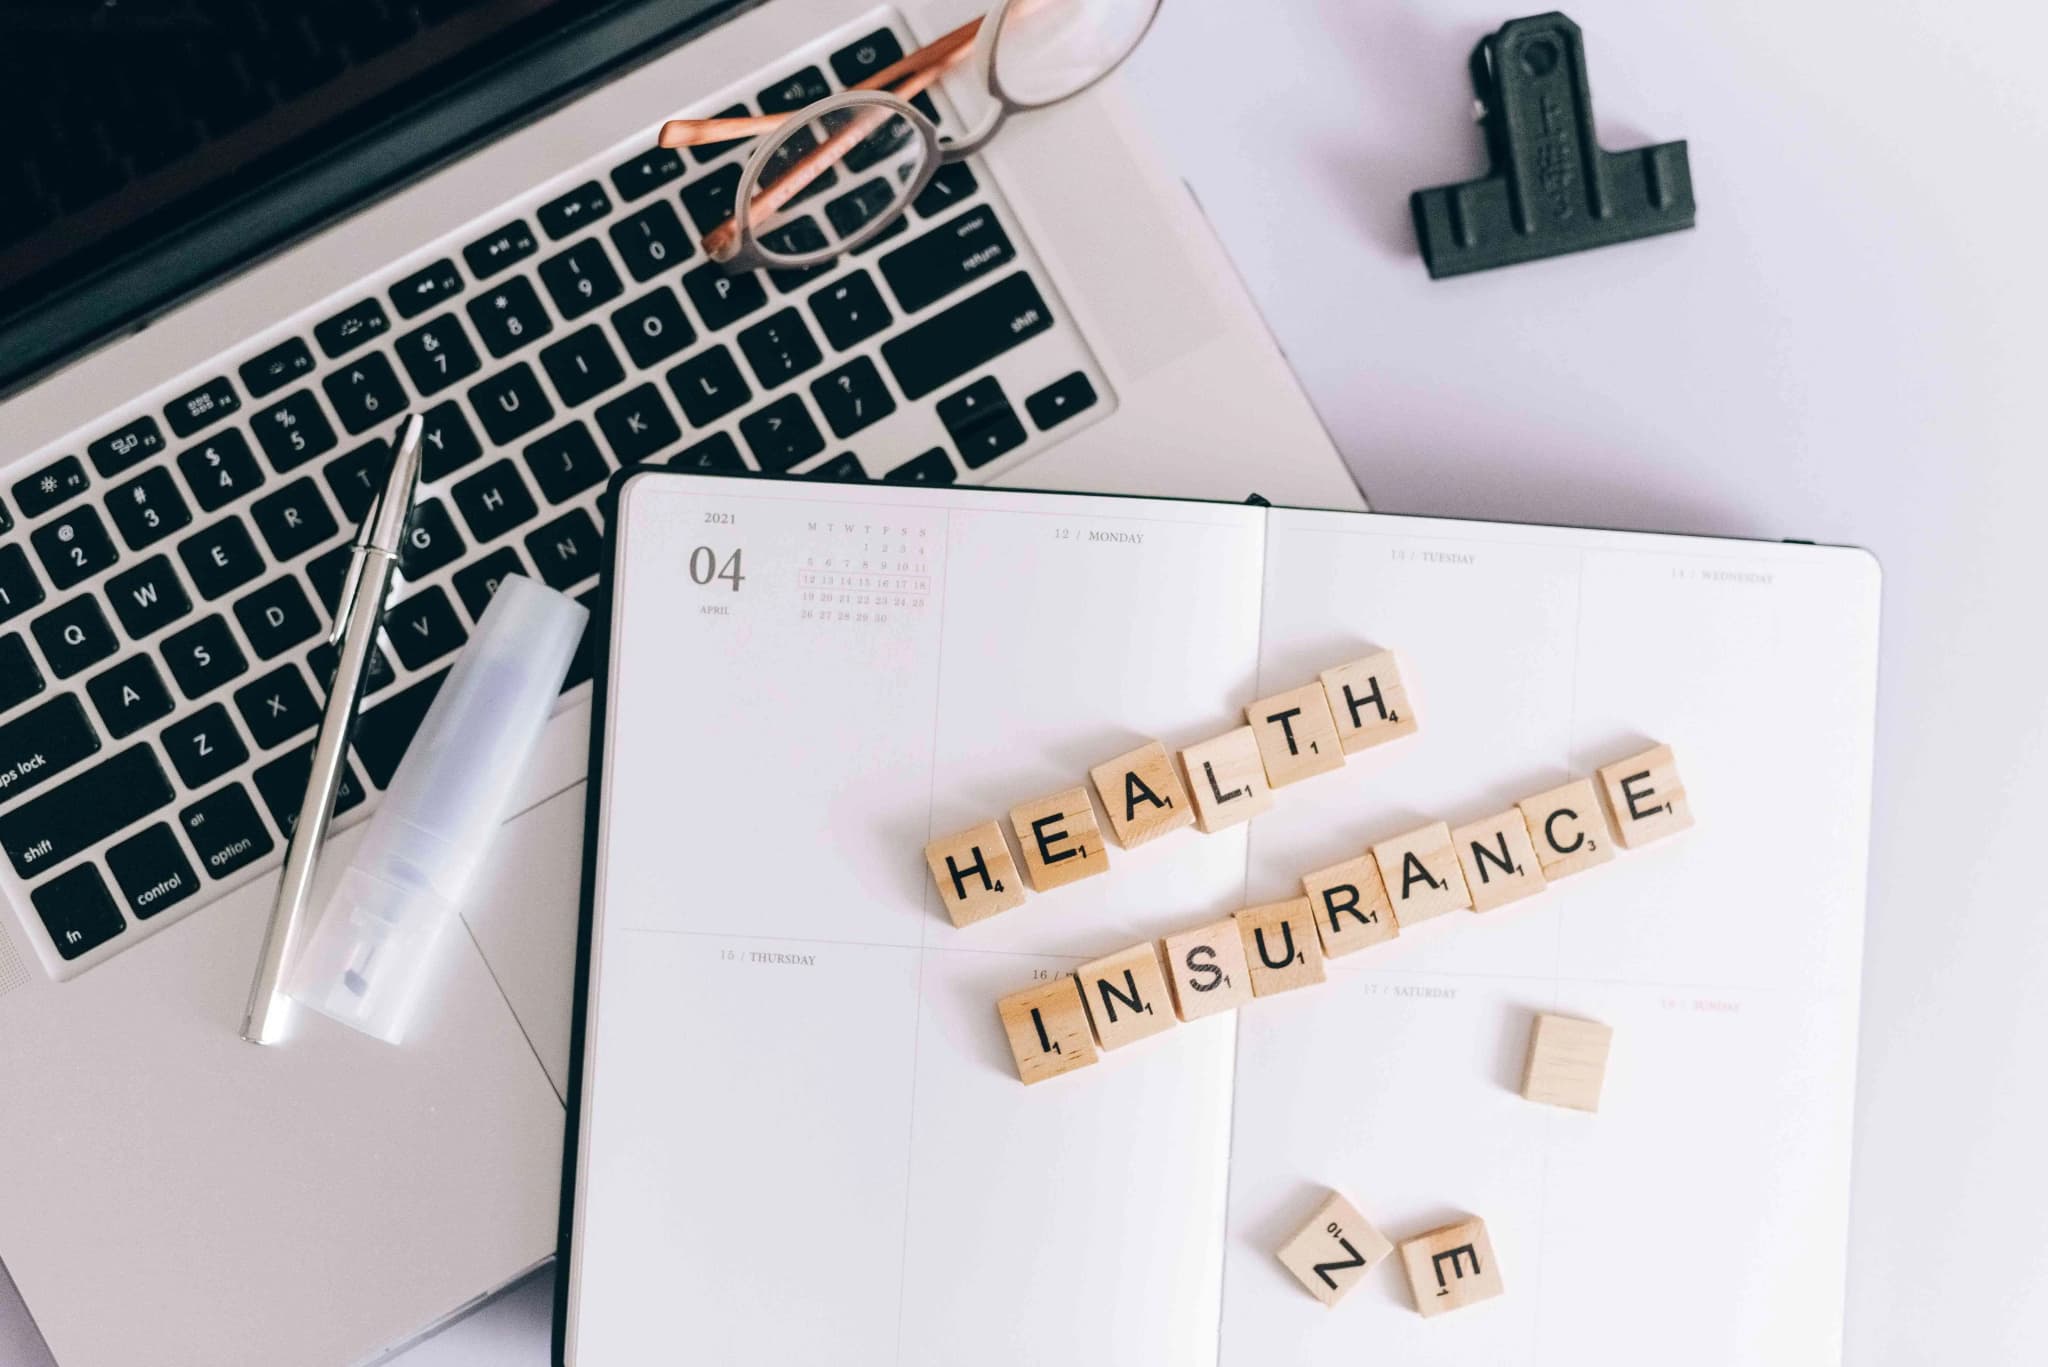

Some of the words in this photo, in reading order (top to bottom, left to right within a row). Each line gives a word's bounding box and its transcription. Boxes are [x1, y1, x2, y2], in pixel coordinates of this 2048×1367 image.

[650, 242, 665, 259] 0
[963, 246, 1002, 273] return
[579, 279, 592, 296] 9
[714, 277, 731, 299] P
[507, 317, 522, 335] 8
[644, 317, 662, 336] O
[1010, 309, 1040, 332] shift
[423, 334, 439, 351] &
[435, 354, 446, 372] 7
[700, 378, 717, 394] L
[837, 375, 853, 394] ?
[366, 394, 378, 410] 6
[500, 390, 519, 411] U
[275, 410, 295, 427] %
[628, 413, 646, 433] K
[291, 431, 305, 450] 5
[428, 430, 443, 449] Y
[206, 448, 220, 466] $
[563, 452, 572, 471] J
[220, 470, 232, 486] 4
[357, 470, 370, 486] T
[134, 487, 145, 504] #
[483, 489, 503, 510] H
[145, 509, 159, 527] 3
[285, 508, 301, 527] R
[705, 513, 734, 524] 2021
[58, 525, 74, 541] @
[411, 527, 431, 549] G
[1089, 531, 1143, 543] MONDAY
[71, 548, 87, 566] 2
[212, 546, 228, 566] E
[557, 539, 577, 559] N
[1422, 550, 1476, 565] TUESDAY
[690, 546, 745, 592] 04
[134, 583, 157, 607] W
[266, 607, 284, 627] D
[700, 605, 729, 616] APRIL
[64, 625, 85, 644] Q
[413, 617, 428, 635] V
[194, 646, 210, 666] S
[123, 686, 140, 706] A
[267, 695, 286, 716] X
[194, 734, 212, 756] Z
[17, 754, 46, 774] lock
[190, 813, 205, 828] alt
[23, 839, 53, 864] shift
[209, 837, 252, 867] option
[137, 873, 182, 906] control
[66, 929, 82, 944] fn
[750, 951, 816, 966] THURSDAY
[1032, 968, 1048, 981] 16
[1393, 985, 1458, 1000] SATURDAY
[1432, 1243, 1481, 1287] E
